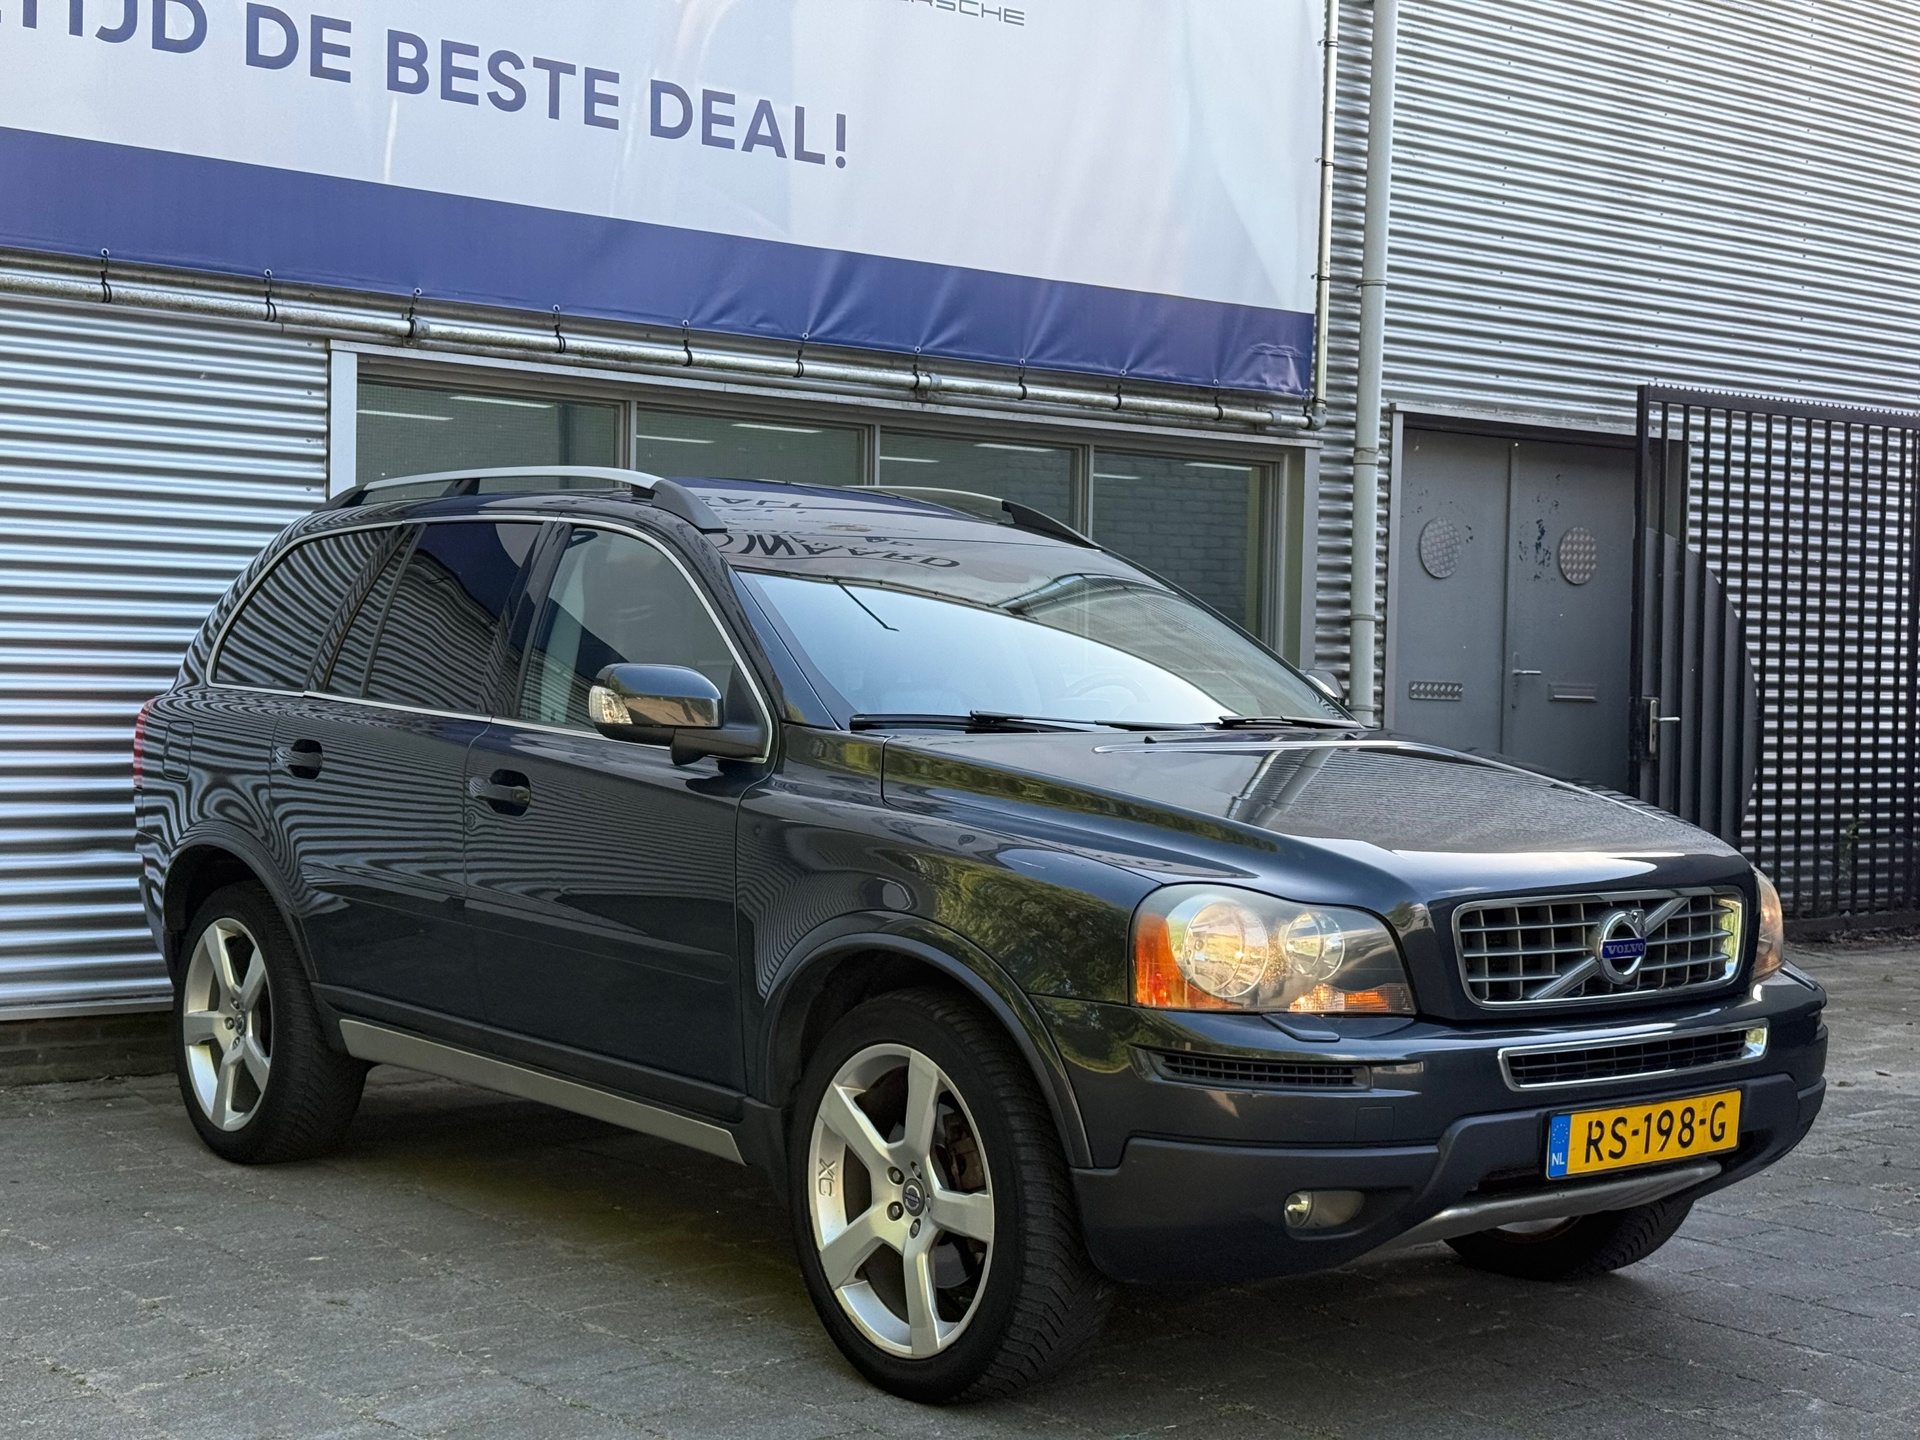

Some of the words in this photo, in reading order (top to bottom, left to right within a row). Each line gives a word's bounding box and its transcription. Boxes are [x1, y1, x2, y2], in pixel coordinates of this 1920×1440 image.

[246, 2, 351, 84] DE
[387, 28, 620, 131] BESTE
[650, 79, 848, 169] DEAL!
[1605, 942, 1645, 955] VOLVO
[1584, 1101, 1726, 1163] RS-198-G
[818, 1157, 837, 1197] XC
[1551, 1152, 1565, 1167] NL
